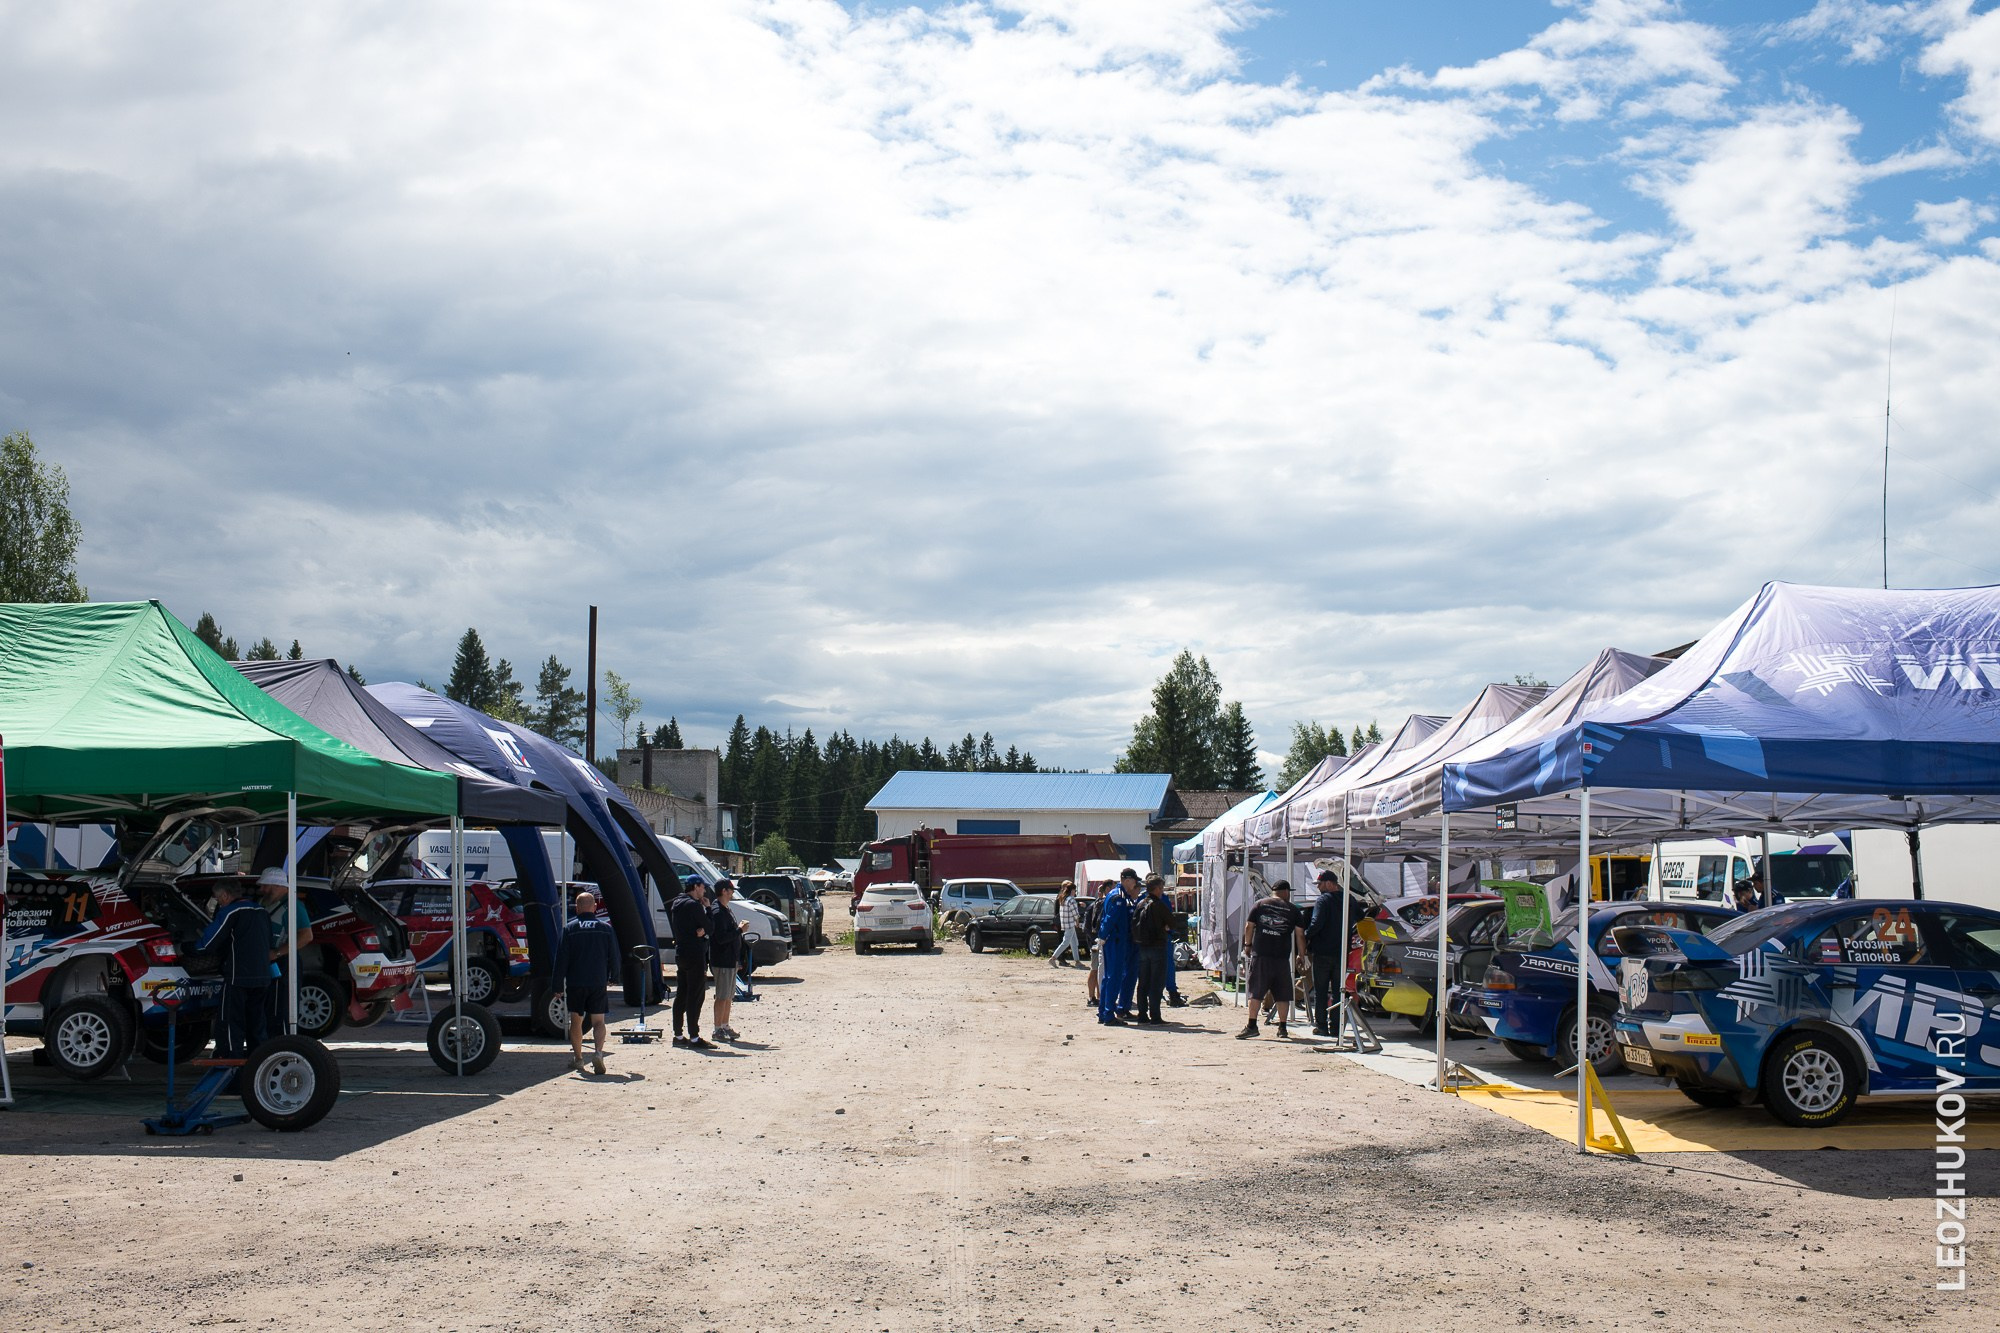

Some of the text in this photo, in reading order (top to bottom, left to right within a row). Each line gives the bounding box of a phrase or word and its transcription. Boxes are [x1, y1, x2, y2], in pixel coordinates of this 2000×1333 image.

[1662, 861, 1684, 878] APECS
[64, 893, 89, 922] 11
[1418, 898, 1439, 915] 33
[105, 918, 142, 932] VRT team
[321, 920, 337, 930] VRT
[579, 920, 599, 928] VRT
[1872, 907, 1916, 942] 24
[5, 934, 44, 968] RT
[1843, 937, 1893, 950] Рогозин
[1411, 950, 1439, 959] RAVE
[1848, 950, 1901, 962] Гапонов
[1529, 958, 1580, 974] RAVENO
[1686, 1036, 1718, 1045] PIRELLI
[1800, 1095, 1848, 1120] SCORPION
